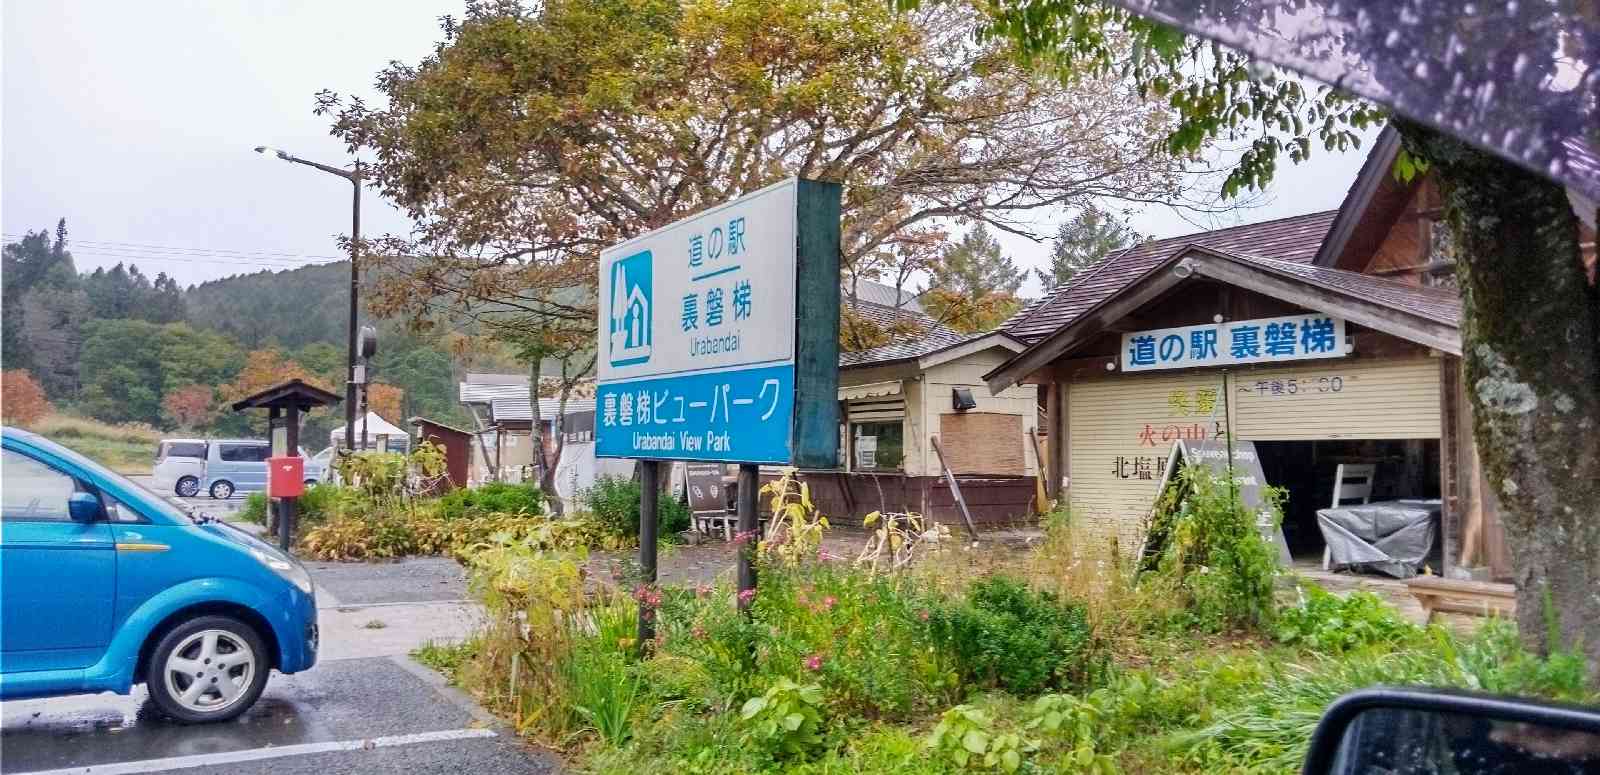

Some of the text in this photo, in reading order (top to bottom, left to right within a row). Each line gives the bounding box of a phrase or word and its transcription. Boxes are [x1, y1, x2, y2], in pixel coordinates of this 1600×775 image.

[688, 216, 746, 268] 道の駅
[681, 280, 751, 332] 裏磐梯
[690, 329, 740, 357] Urabandai
[1129, 317, 1335, 366] 道の駅 裏磐梯
[603, 379, 780, 427] 裏磐梯ビューパーク
[632, 430, 731, 452] Urabandai View Park
